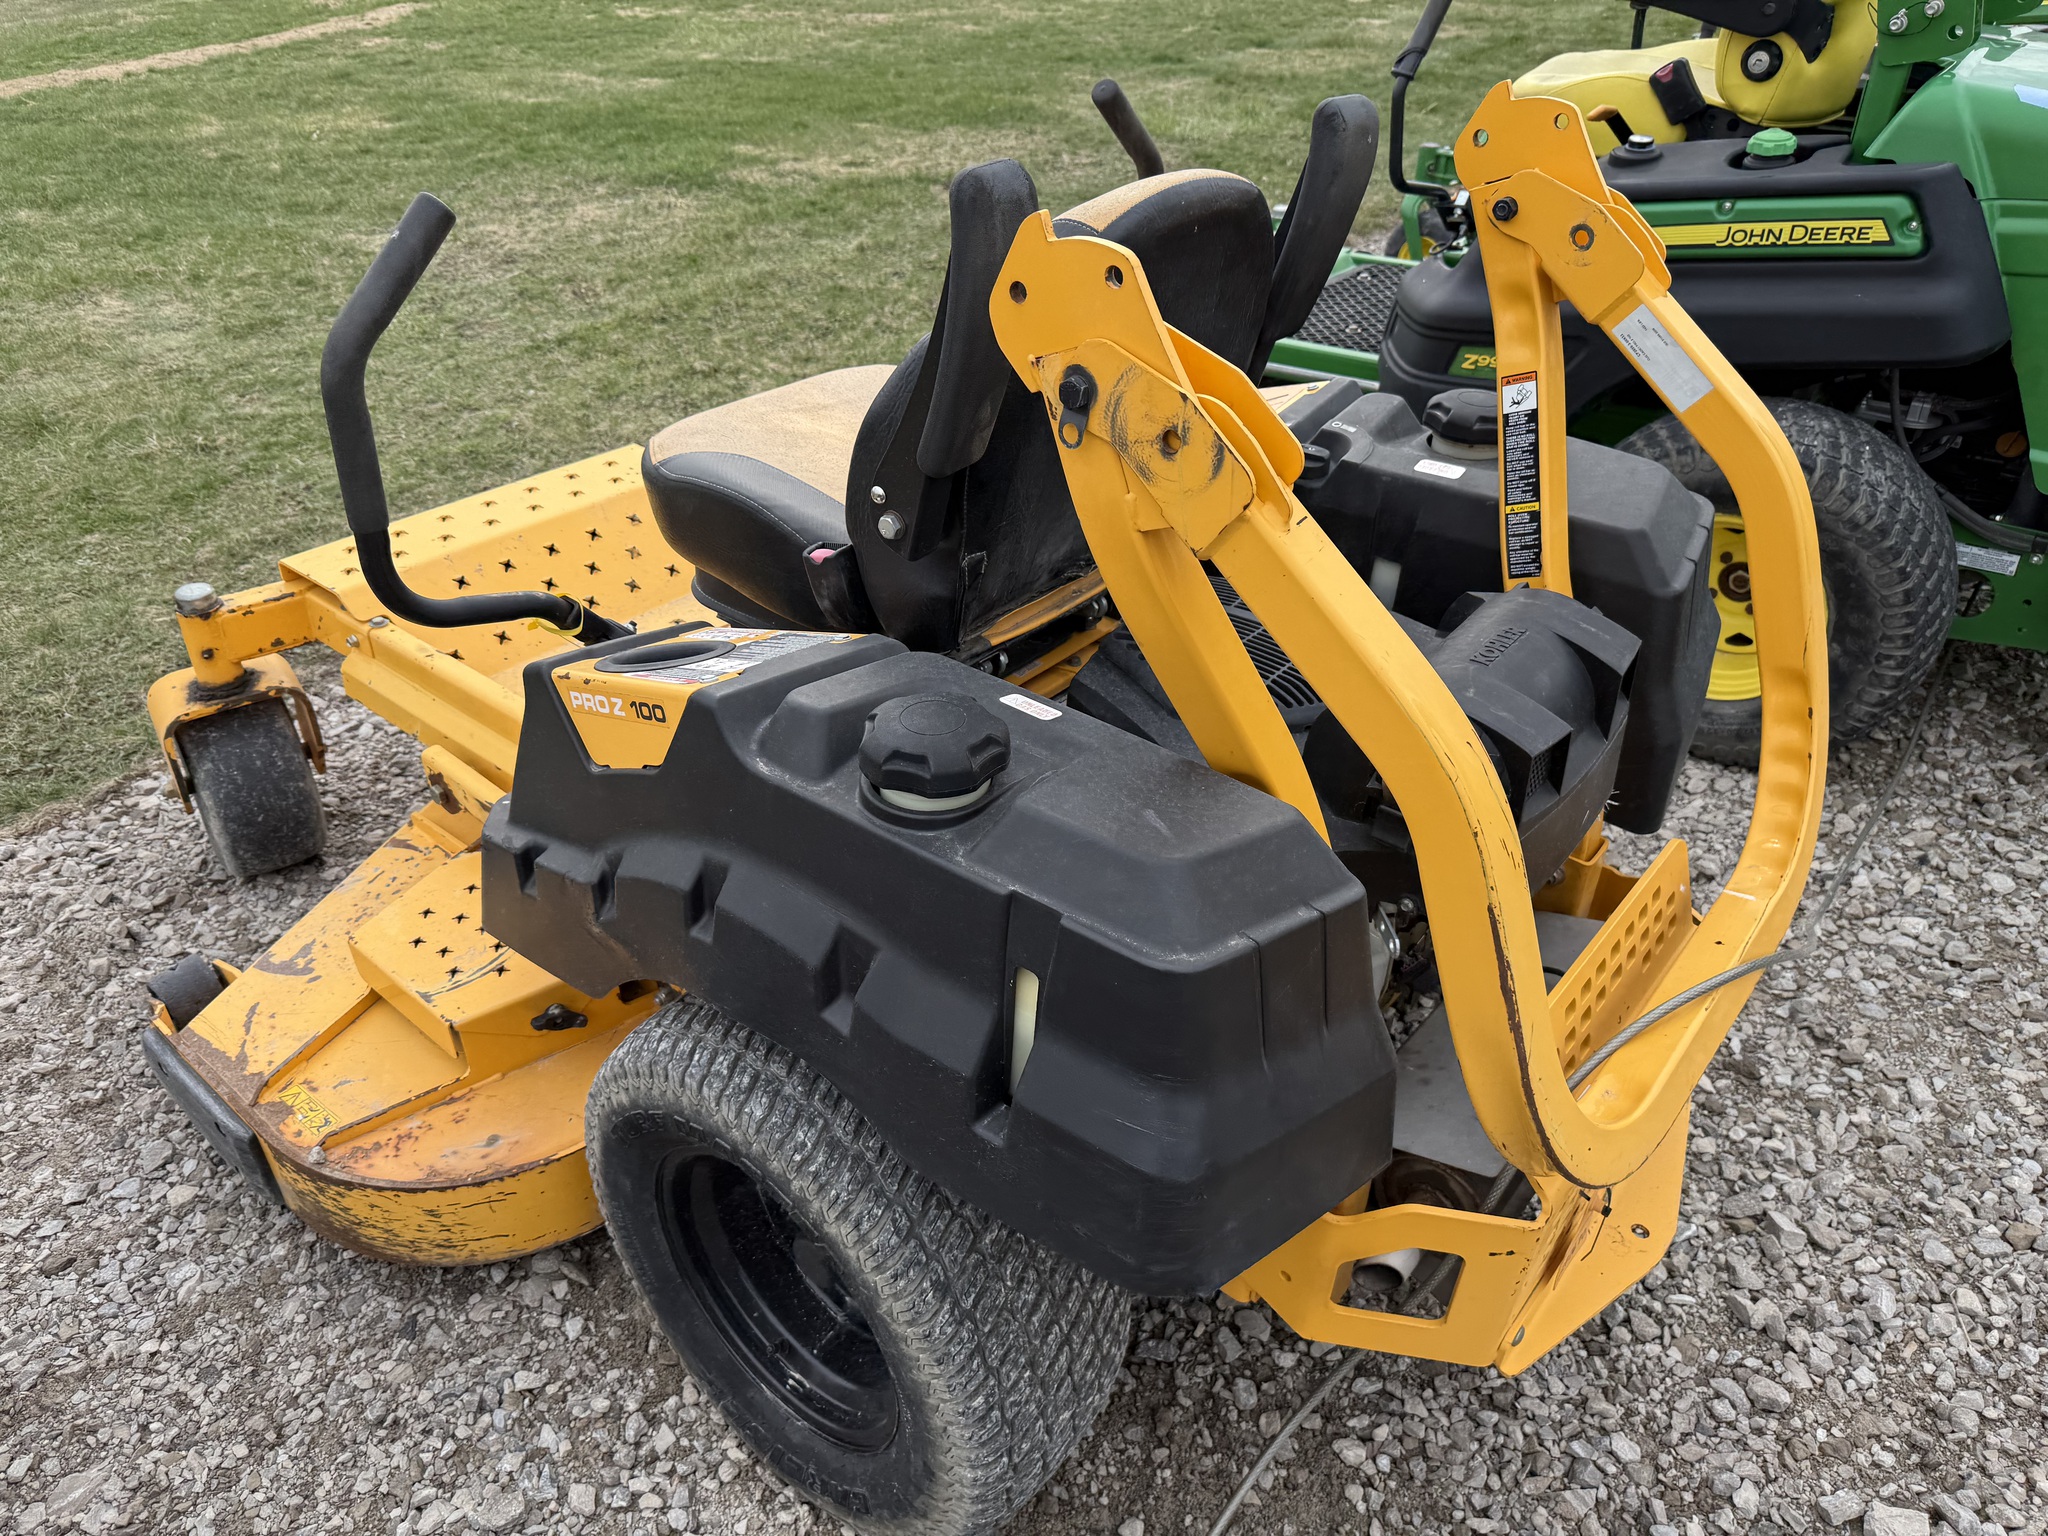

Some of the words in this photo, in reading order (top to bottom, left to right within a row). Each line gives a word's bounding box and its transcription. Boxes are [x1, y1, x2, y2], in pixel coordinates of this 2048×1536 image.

[1716, 226, 1784, 244] JOHN
[1788, 224, 1874, 243] DEERE
[1511, 374, 1533, 384] WARNING
[1469, 627, 1528, 667] KOHLER
[569, 691, 610, 714] PRO
[610, 697, 626, 717] Z
[629, 700, 667, 723] 100
